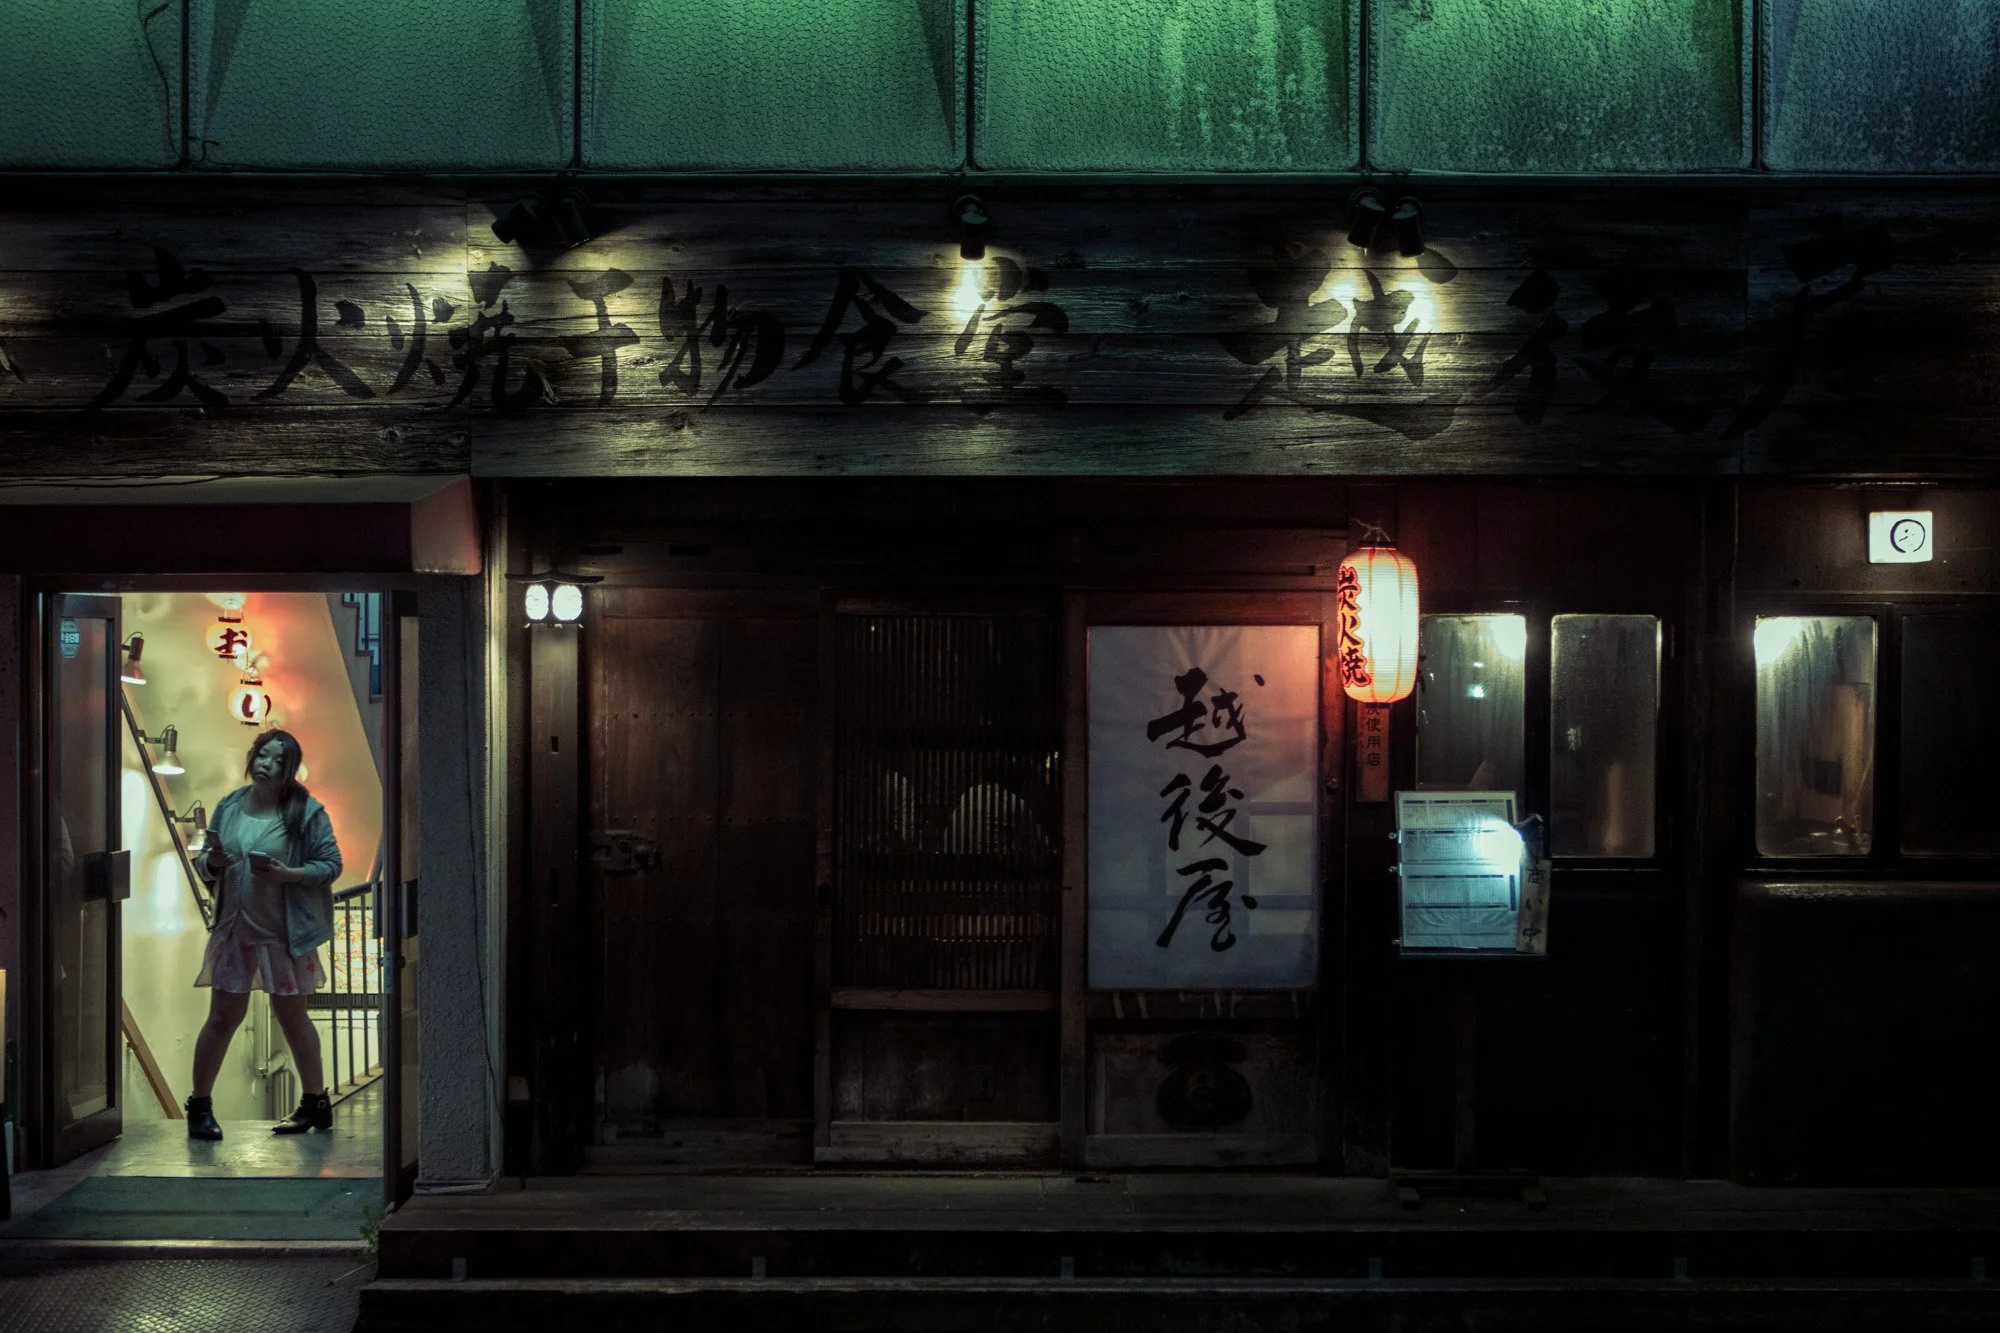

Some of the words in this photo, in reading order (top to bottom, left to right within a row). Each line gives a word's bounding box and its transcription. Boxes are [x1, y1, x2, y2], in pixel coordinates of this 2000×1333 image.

[85, 246, 1070, 412] 炭火焼干物食堂
[214, 627, 249, 654] お
[1339, 567, 1371, 685] 炭火焼
[241, 694, 272, 718] い
[1148, 667, 1266, 952] 越後屋
